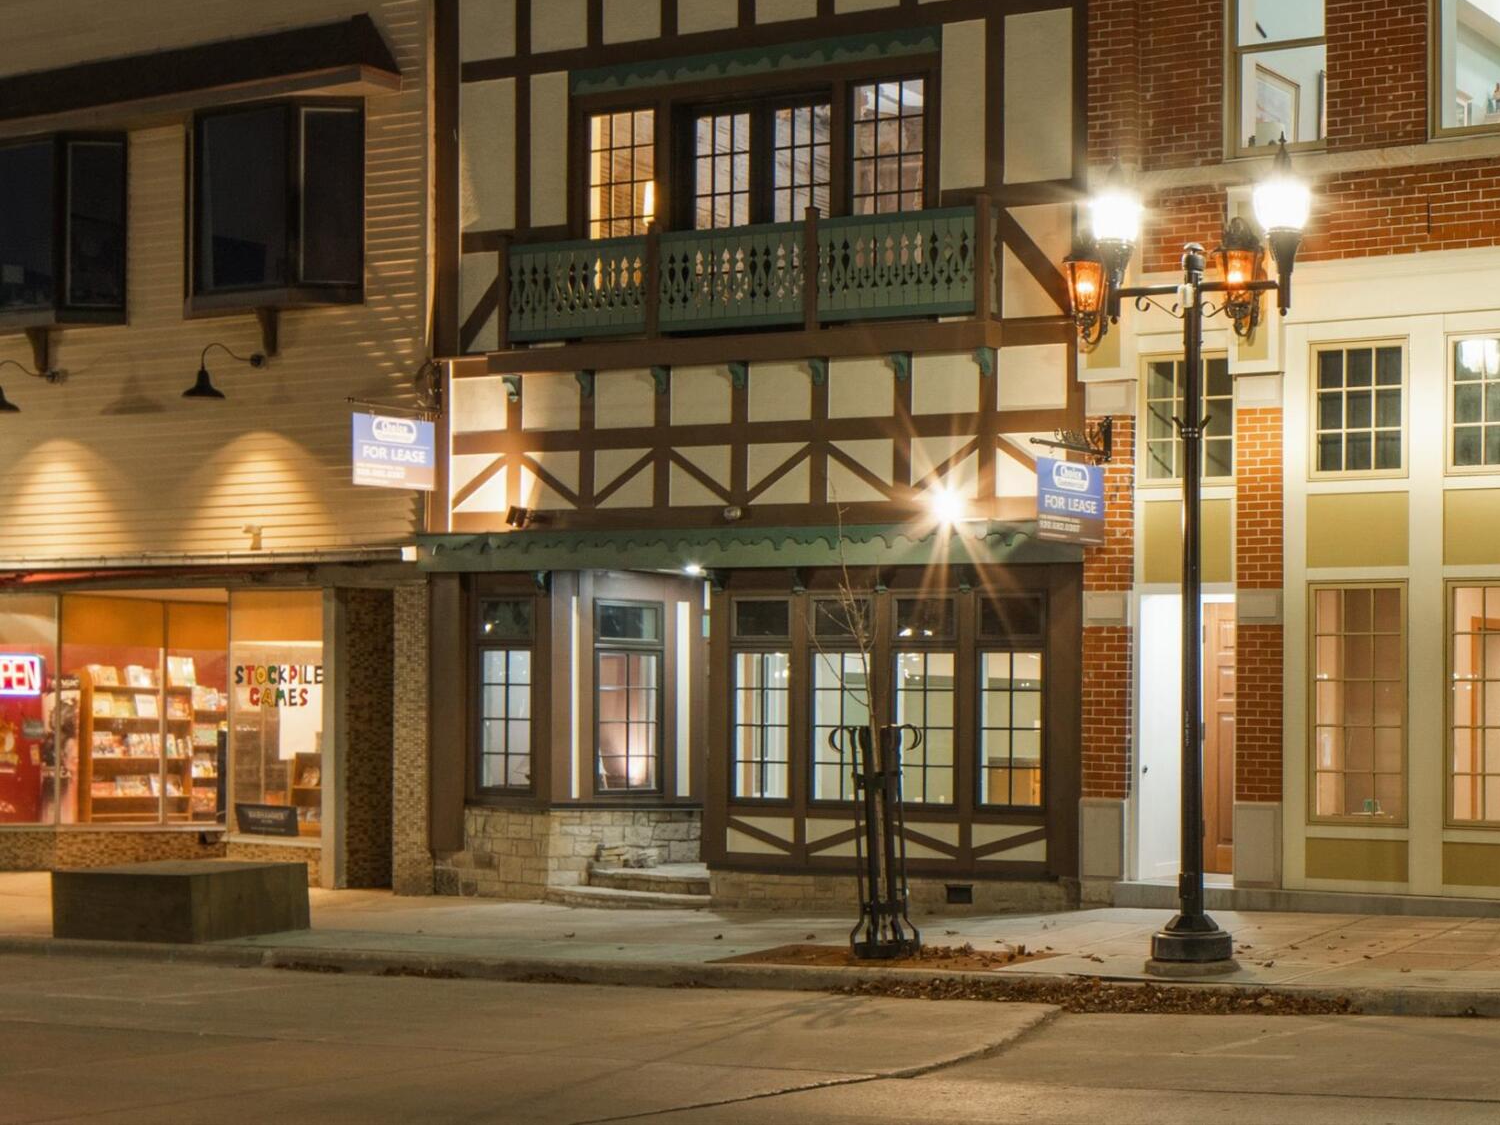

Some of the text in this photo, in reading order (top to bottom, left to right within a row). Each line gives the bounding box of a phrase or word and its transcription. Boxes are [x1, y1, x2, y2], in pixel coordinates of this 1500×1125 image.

[362, 445, 426, 464] FOR LEASE
[1044, 494, 1098, 514] FOR LEASE
[0, 659, 39, 690] PEN
[235, 665, 323, 685] STOCKPILE
[249, 687, 308, 707] GAMES
